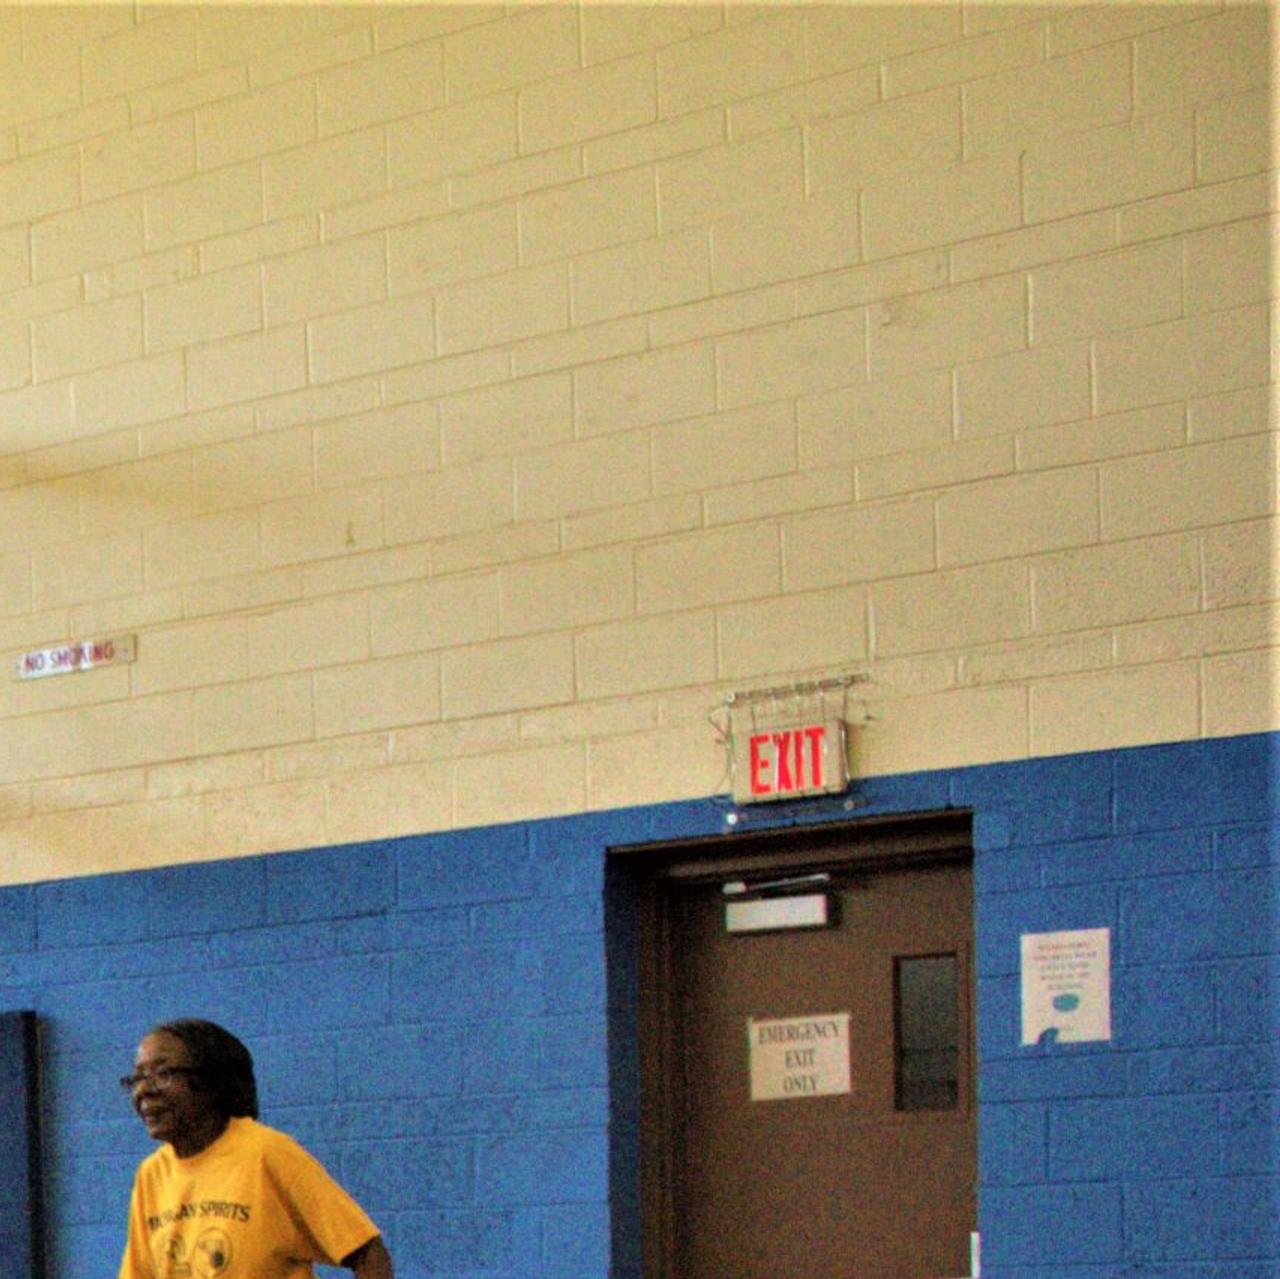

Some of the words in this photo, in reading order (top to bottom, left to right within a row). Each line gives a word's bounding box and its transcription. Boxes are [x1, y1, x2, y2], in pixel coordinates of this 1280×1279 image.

[24, 652, 45, 672] NO
[750, 726, 826, 794] EXIT
[759, 1020, 839, 1044] EMERGENCY
[785, 1048, 816, 1068] EXIT
[783, 1074, 816, 1093] ONLY
[200, 1201, 250, 1222] SPIRITS
